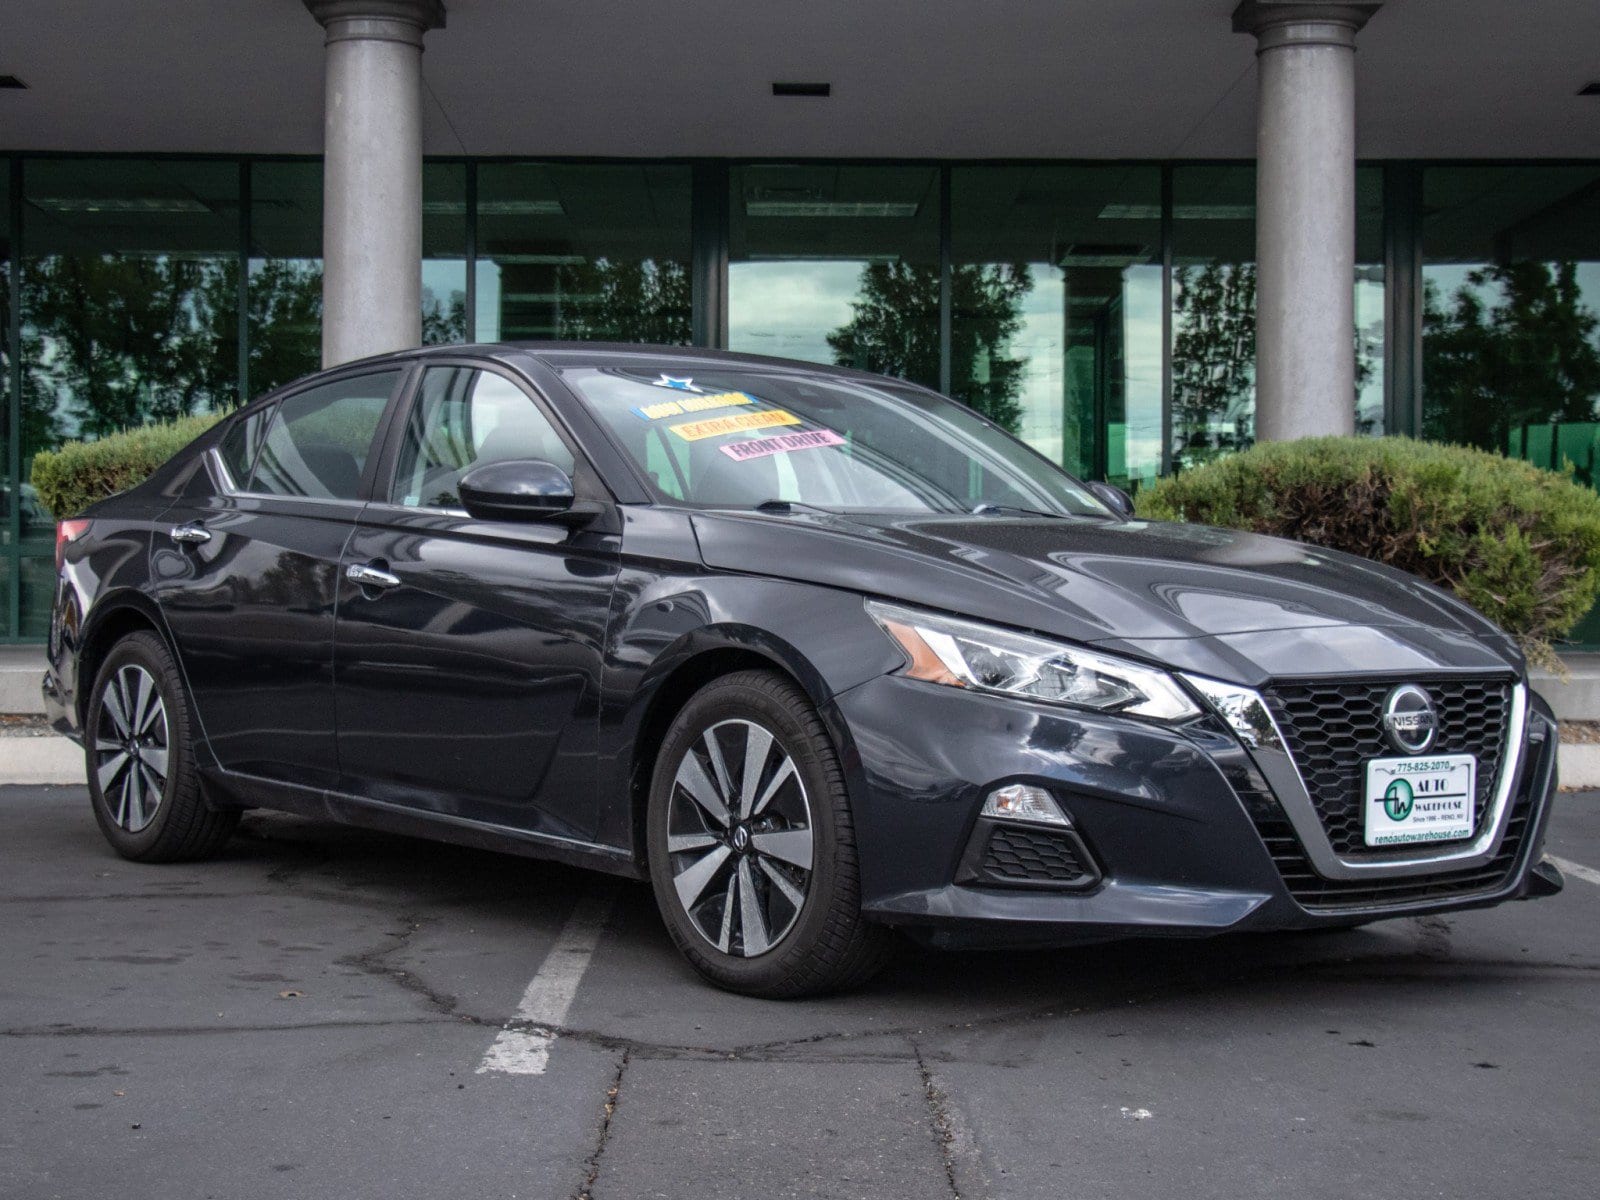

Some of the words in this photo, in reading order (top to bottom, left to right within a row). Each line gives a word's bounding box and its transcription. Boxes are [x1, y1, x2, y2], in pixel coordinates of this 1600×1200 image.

[682, 418, 735, 438] EXTRA
[735, 411, 788, 430] CLEAN
[729, 437, 784, 458] FRONT
[781, 432, 832, 448] DRIVE
[1393, 714, 1433, 726] NISSAN
[1397, 761, 1450, 772] 775-825-2070
[1416, 779, 1449, 792] AUTO
[1415, 801, 1463, 812] WAREHOUSE
[1375, 829, 1469, 844] renoautowarehouse.com
